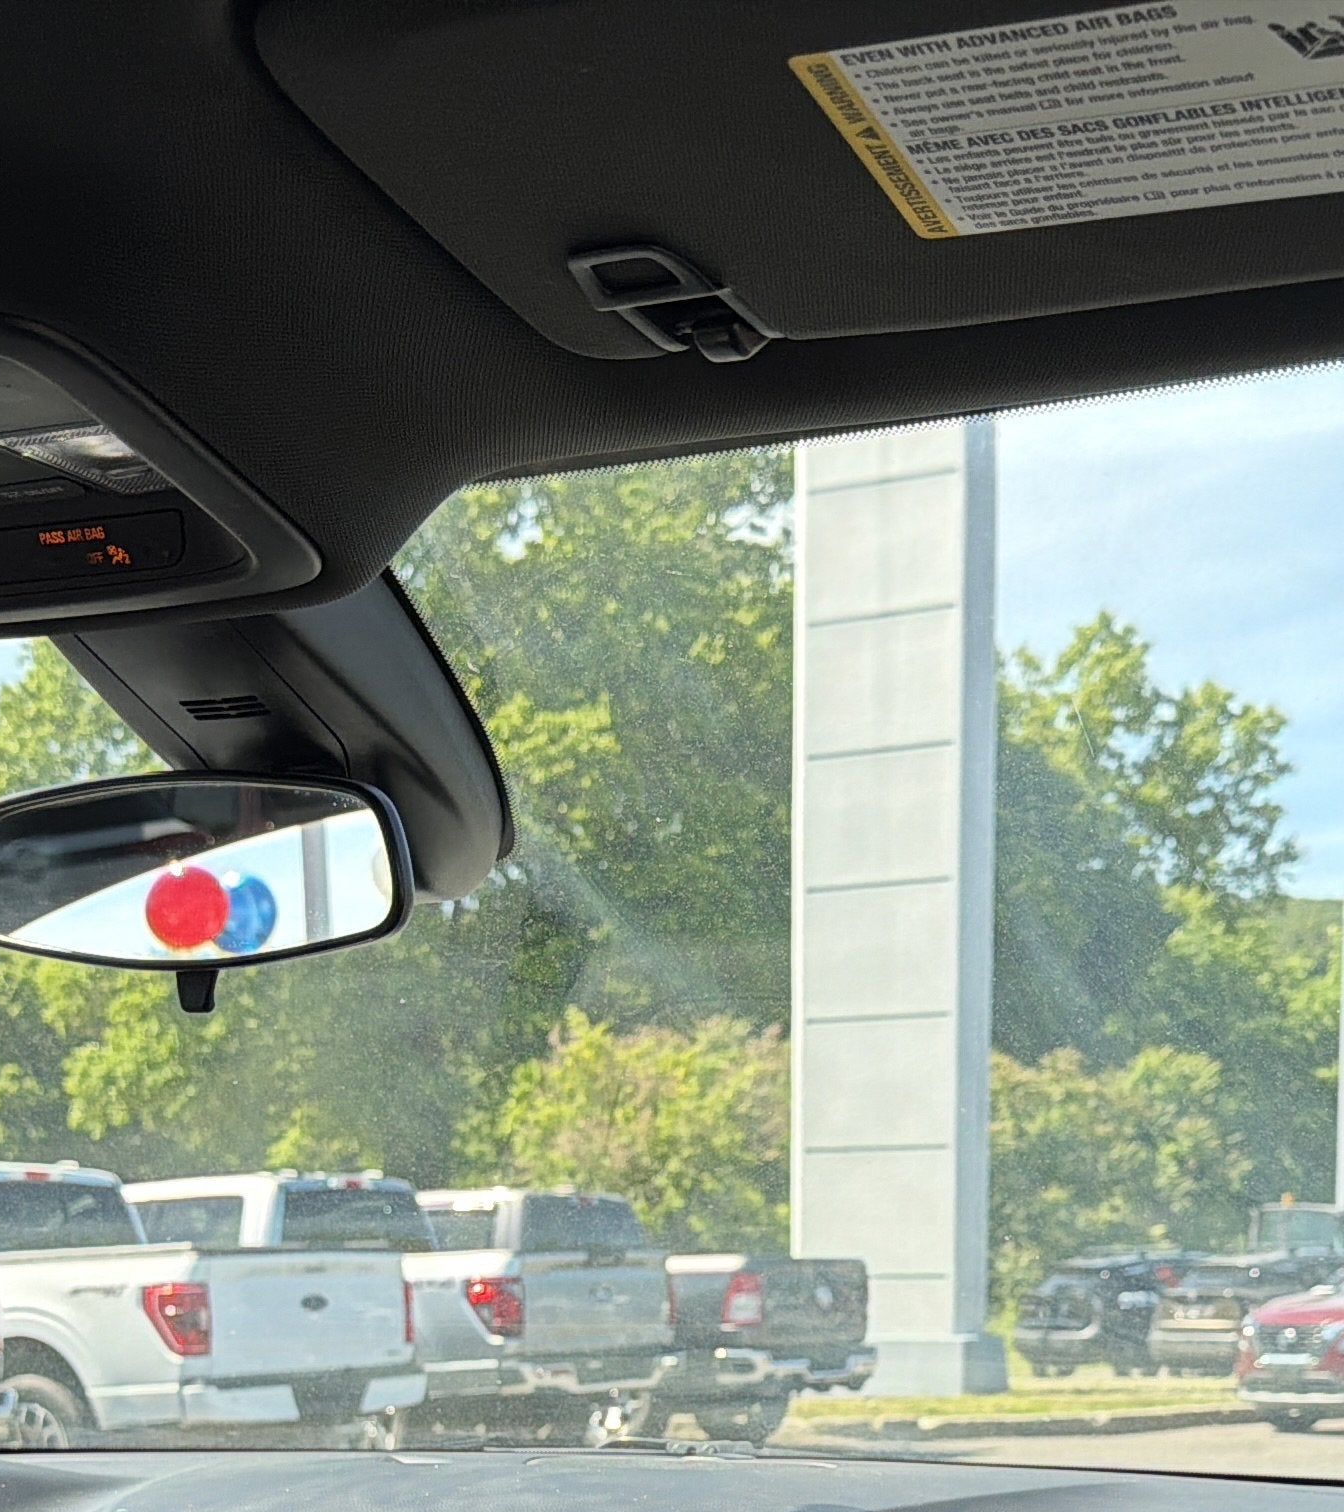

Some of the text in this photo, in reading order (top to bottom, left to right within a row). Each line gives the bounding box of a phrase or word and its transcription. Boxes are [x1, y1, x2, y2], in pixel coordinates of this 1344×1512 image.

[838, 6, 1180, 66] EVEN WITH ADVANCED AIR BAGS
[807, 63, 867, 125] WARNING
[903, 137, 965, 155] MÊME
[962, 130, 1016, 148] AVEC
[1013, 125, 1056, 141] DES
[1053, 118, 1111, 136] SACS
[1108, 101, 1239, 129] GONFLABLES
[865, 144, 948, 233] AVERTISSEMENT
[38, 525, 106, 545] PASS AIR BAG
